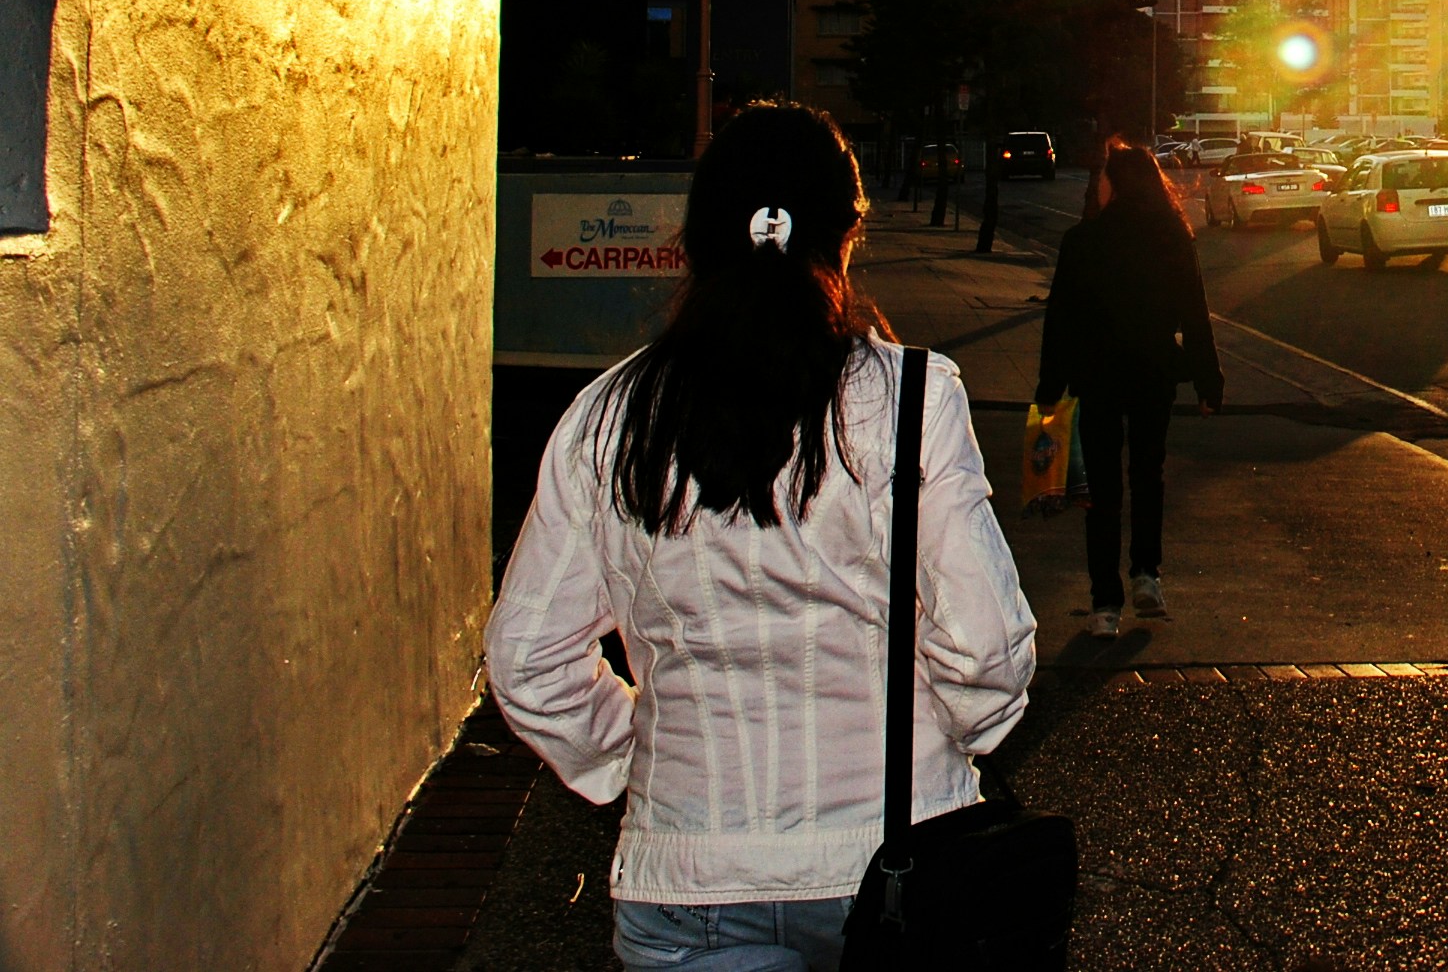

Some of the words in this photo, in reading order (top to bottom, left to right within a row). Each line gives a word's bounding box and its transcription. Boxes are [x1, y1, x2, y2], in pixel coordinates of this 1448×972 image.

[581, 219, 596, 232] The
[585, 218, 654, 241] Moroccan
[566, 247, 688, 270] CARPARK
